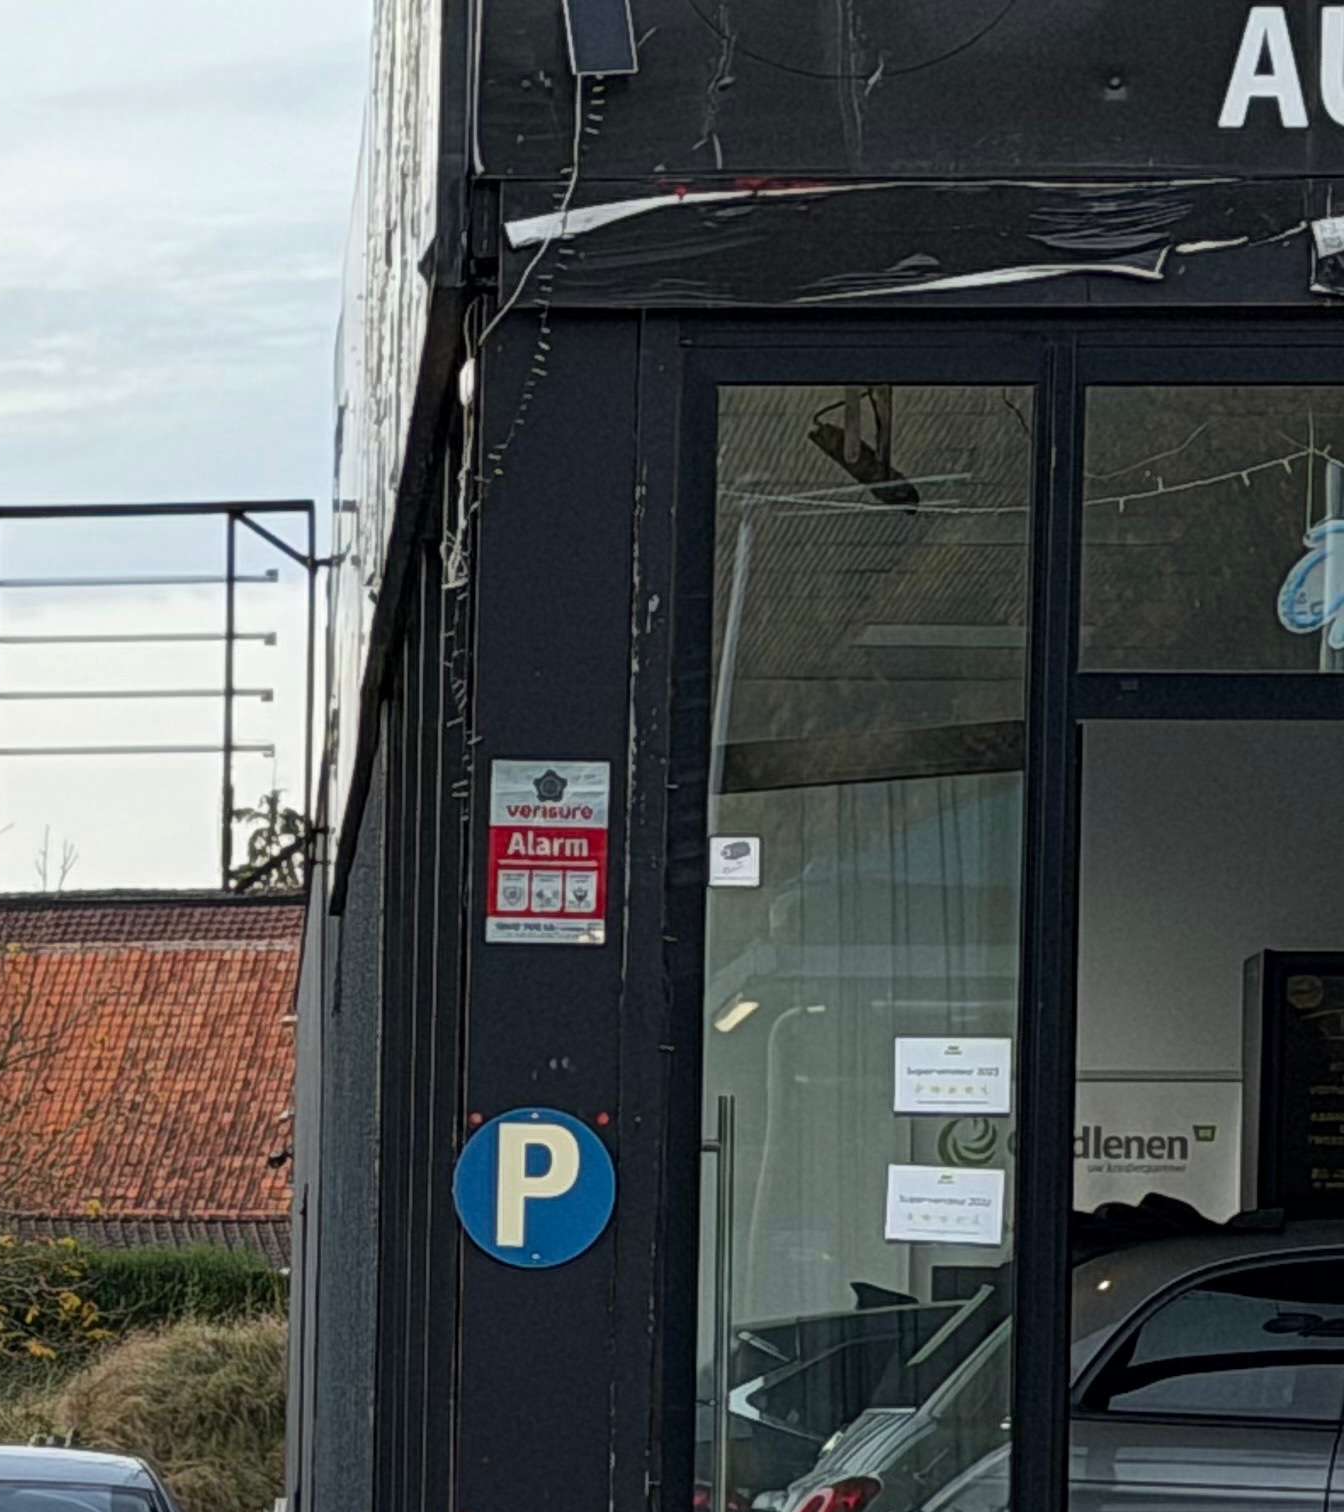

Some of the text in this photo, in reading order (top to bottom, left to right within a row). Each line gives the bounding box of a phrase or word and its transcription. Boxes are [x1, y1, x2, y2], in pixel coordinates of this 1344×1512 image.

[506, 804, 594, 820] verisure
[507, 831, 589, 857] Alarm
[1073, 1125, 1188, 1160] dlenen
[496, 1122, 580, 1248] P
